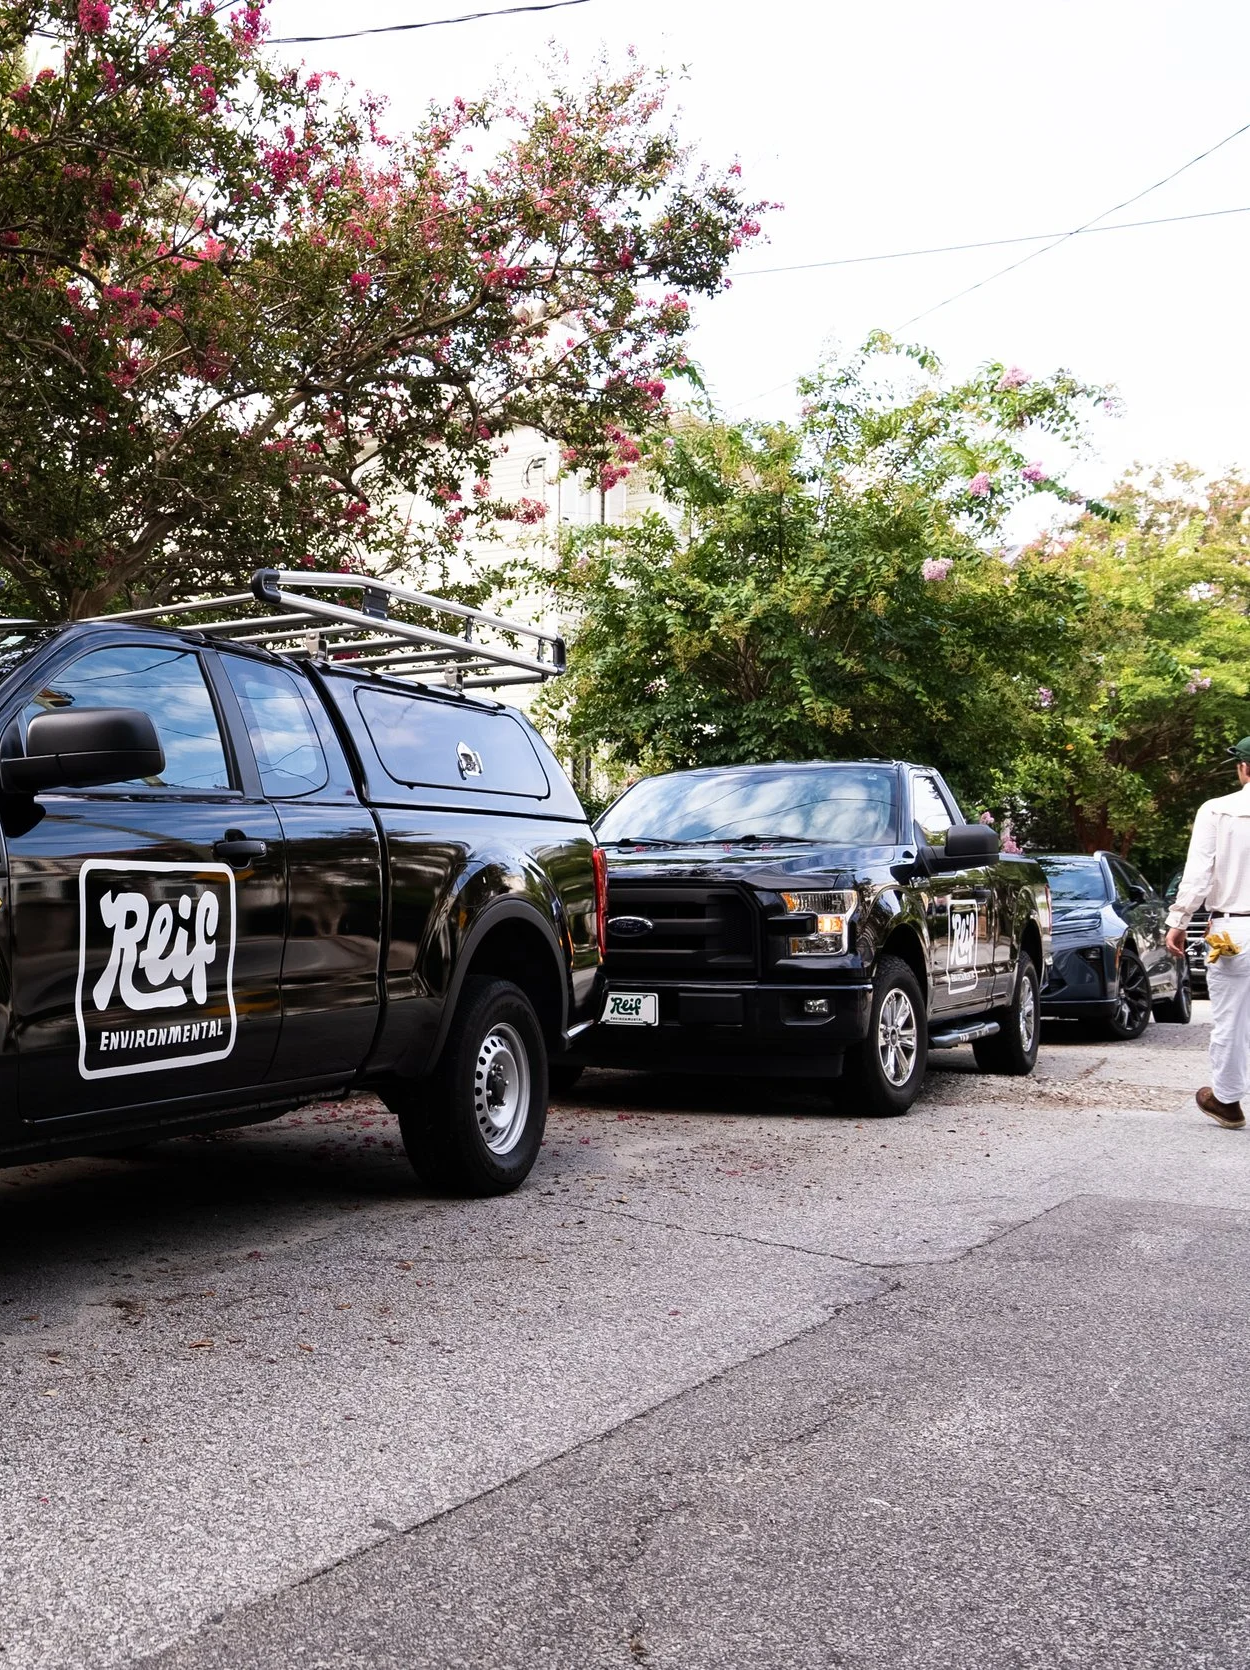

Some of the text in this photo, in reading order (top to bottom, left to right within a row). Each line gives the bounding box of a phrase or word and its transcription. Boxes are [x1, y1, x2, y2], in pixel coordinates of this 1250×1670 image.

[93, 889, 219, 1011] Reif
[951, 912, 975, 966] Reif
[610, 997, 641, 1016] Reif
[100, 1019, 223, 1051] ENVIRONMENTAL
